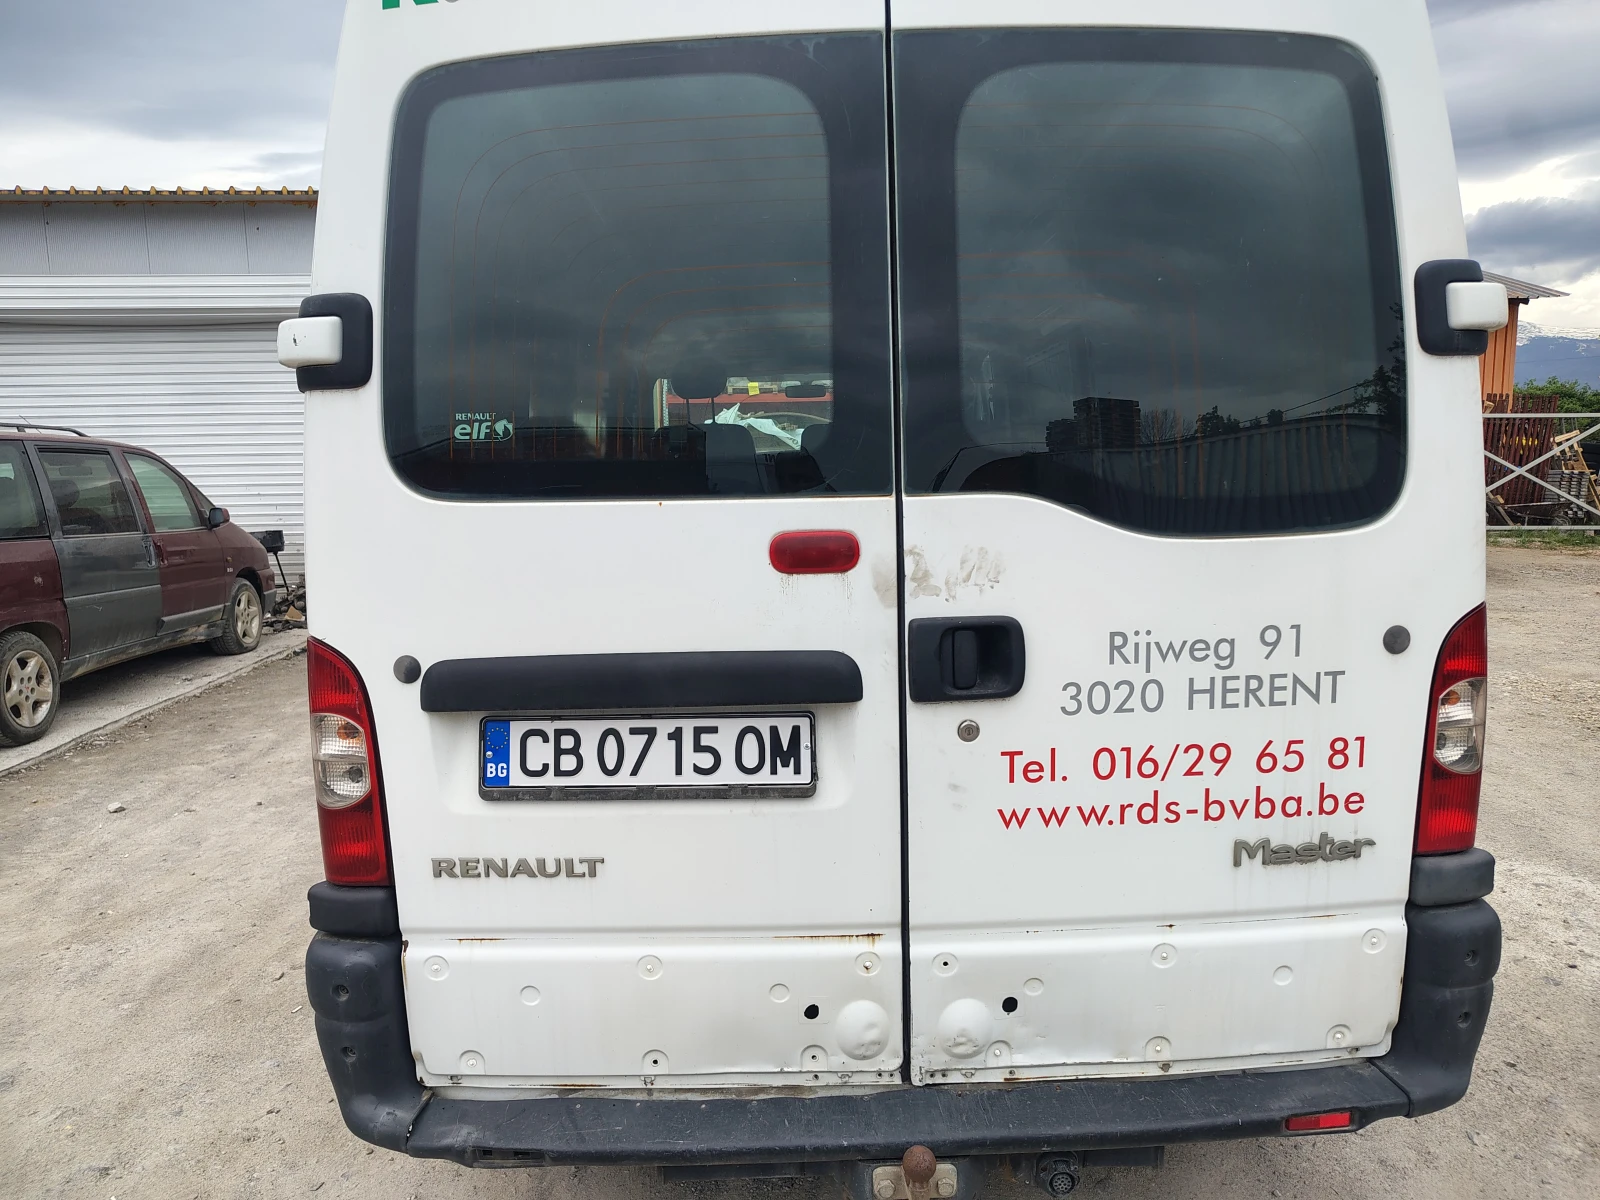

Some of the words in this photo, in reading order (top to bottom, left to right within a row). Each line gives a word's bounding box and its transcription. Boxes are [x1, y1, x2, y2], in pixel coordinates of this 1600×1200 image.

[454, 421, 492, 440] elf
[455, 412, 497, 421] RENAULT
[1108, 629, 1236, 673] Rijweg
[1258, 624, 1302, 661] 91
[1060, 678, 1165, 717] 3020
[1187, 670, 1347, 712] HERENT
[486, 762, 508, 778] BG
[519, 728, 584, 778] CB
[596, 725, 722, 777] 0715
[734, 724, 801, 776] OM
[1000, 747, 1069, 784] Tel.
[1092, 742, 1233, 782] 016/29
[1255, 739, 1305, 774] 65
[1327, 736, 1366, 771] 81
[997, 782, 1366, 830] www.rds-bvba.be
[430, 856, 605, 879] RENAULT
[1232, 831, 1377, 868] Master
